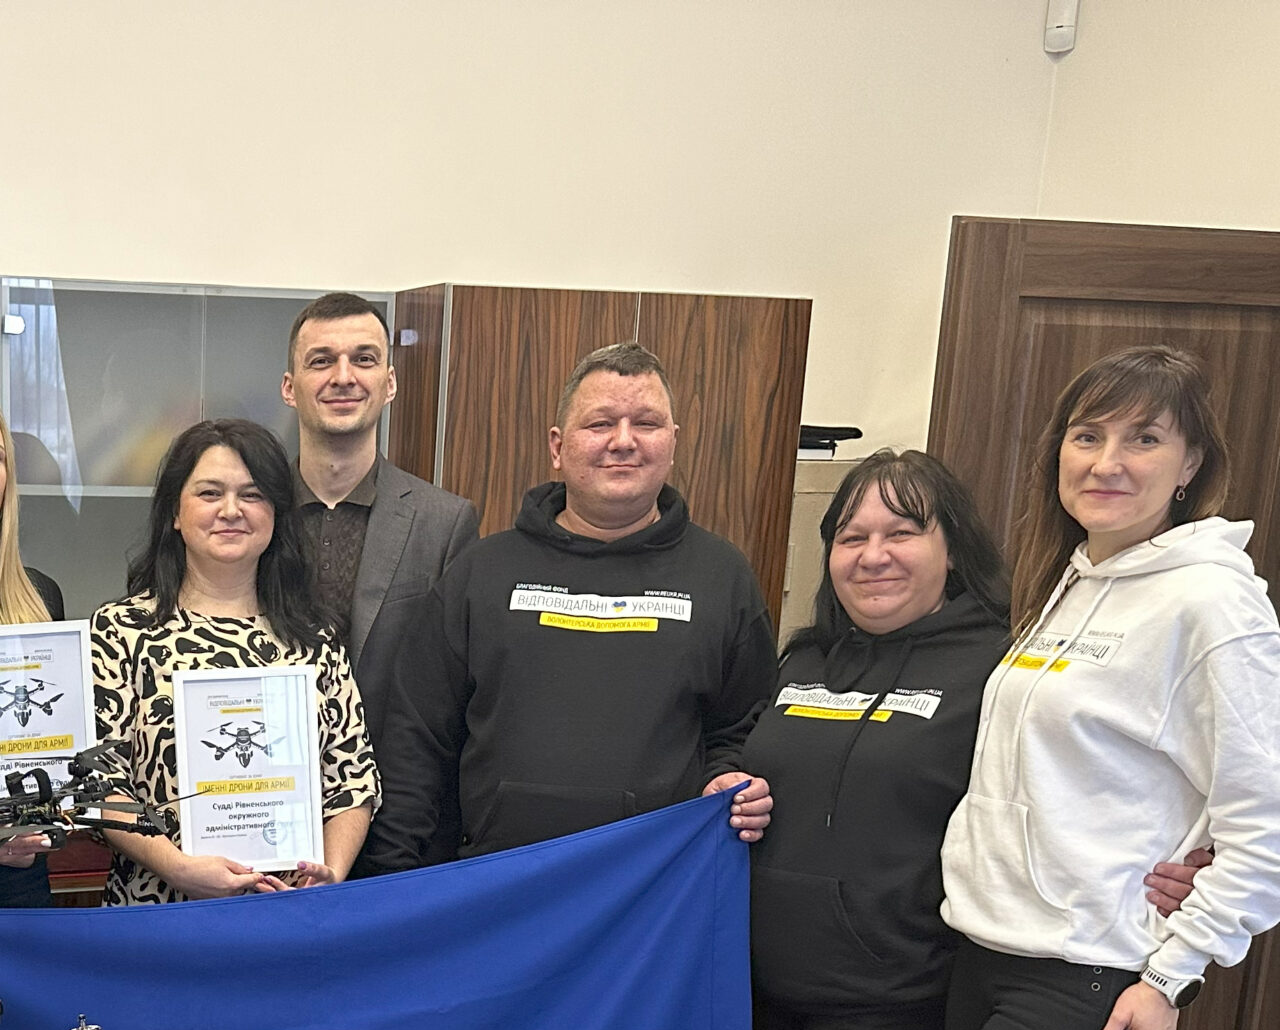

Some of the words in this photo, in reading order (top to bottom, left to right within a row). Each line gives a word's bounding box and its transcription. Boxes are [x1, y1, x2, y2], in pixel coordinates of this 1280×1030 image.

[1067, 642, 1109, 659] КРАЇНЦІ
[883, 698, 930, 711] КРАЇНЦІ
[8, 743, 32, 752] ДРОНИ
[34, 741, 47, 750] ДЛЯ
[50, 739, 68, 747] АРМІЇ
[15, 759, 62, 768] Рівненського
[229, 783, 253, 792] ДРОНИ
[255, 782, 268, 791] ДЛЯ
[236, 800, 284, 808] Рівненського
[229, 812, 269, 820] окружного
[206, 822, 275, 832] адміністративного
